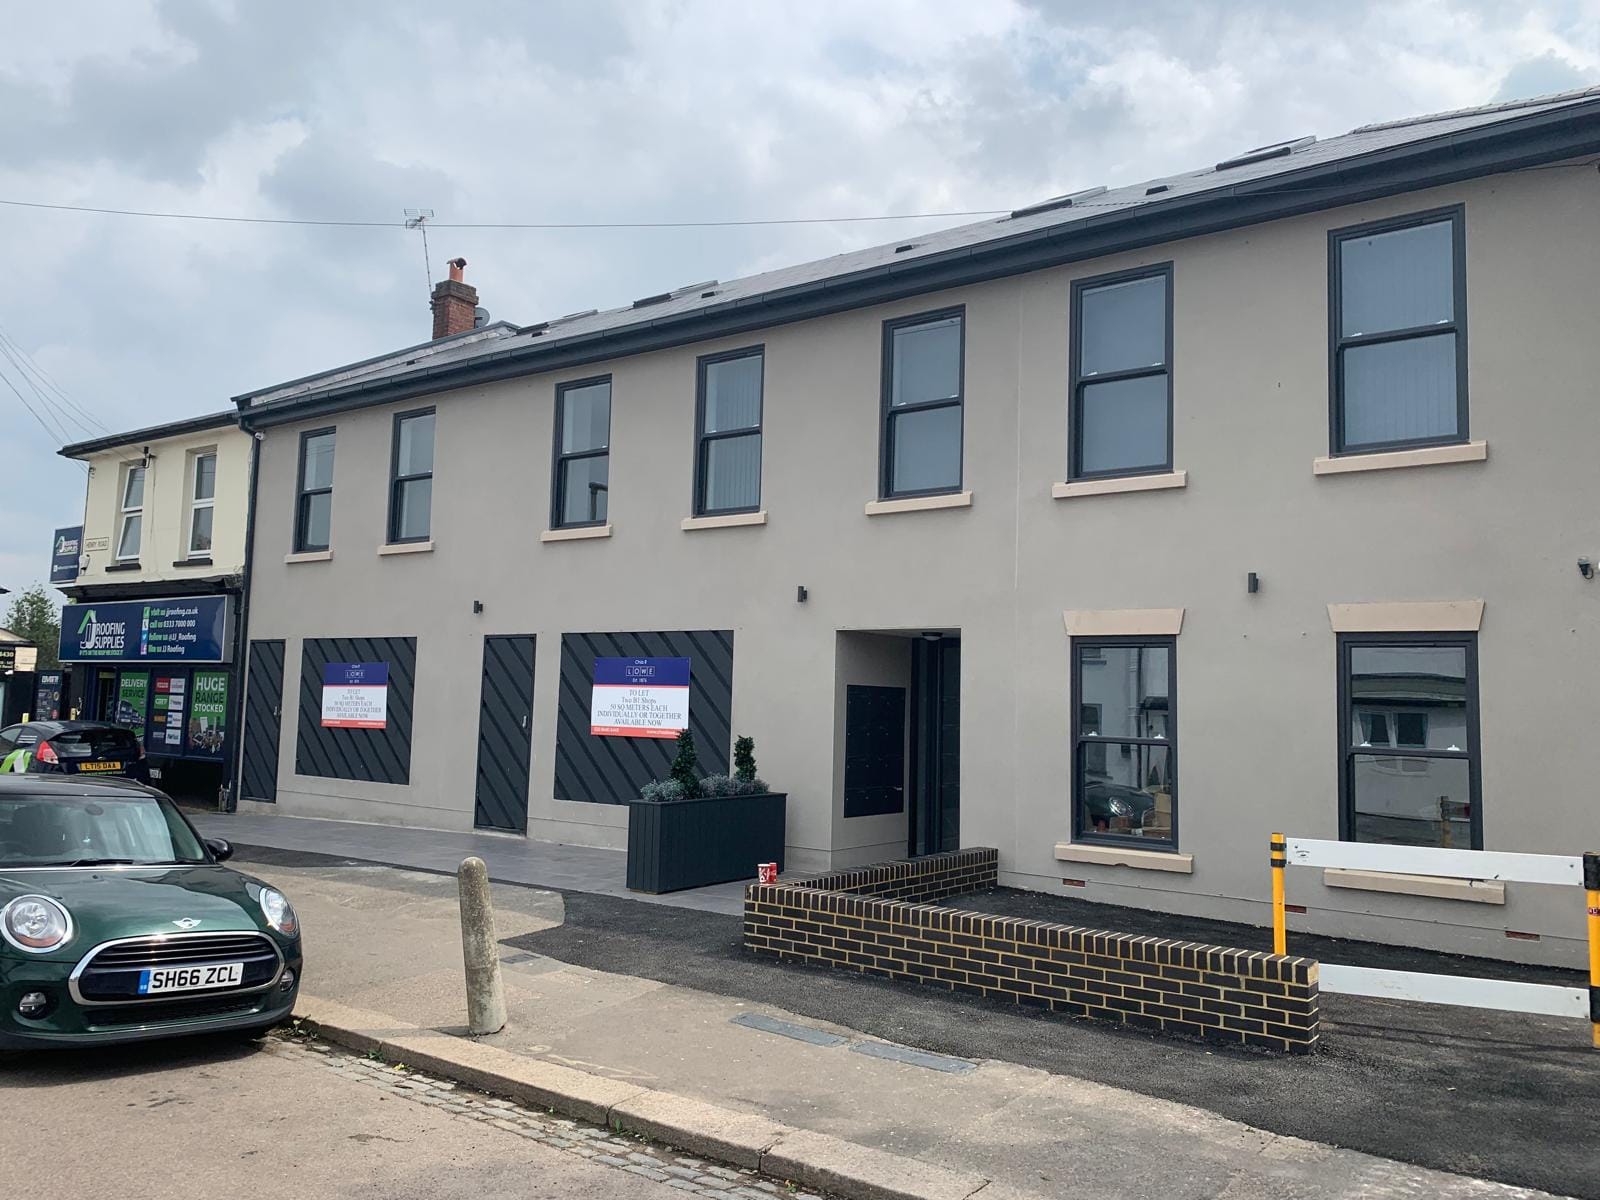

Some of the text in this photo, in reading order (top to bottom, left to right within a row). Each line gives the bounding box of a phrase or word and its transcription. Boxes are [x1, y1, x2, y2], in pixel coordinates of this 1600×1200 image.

[150, 608, 160, 616] visit
[96, 622, 126, 636] ROOFING
[149, 632, 162, 640] follow
[94, 636, 124, 648] SUPPLIES
[148, 644, 156, 652] like
[167, 644, 185, 654] Roofing
[627, 667, 653, 675] LOWE
[120, 678, 147, 688] DELIVERY
[196, 677, 225, 692] HUGE
[122, 688, 144, 698] SERVICE
[195, 692, 224, 703] RANGE
[194, 704, 224, 712] STOCKED
[152, 966, 238, 989] SH66 ZCL
